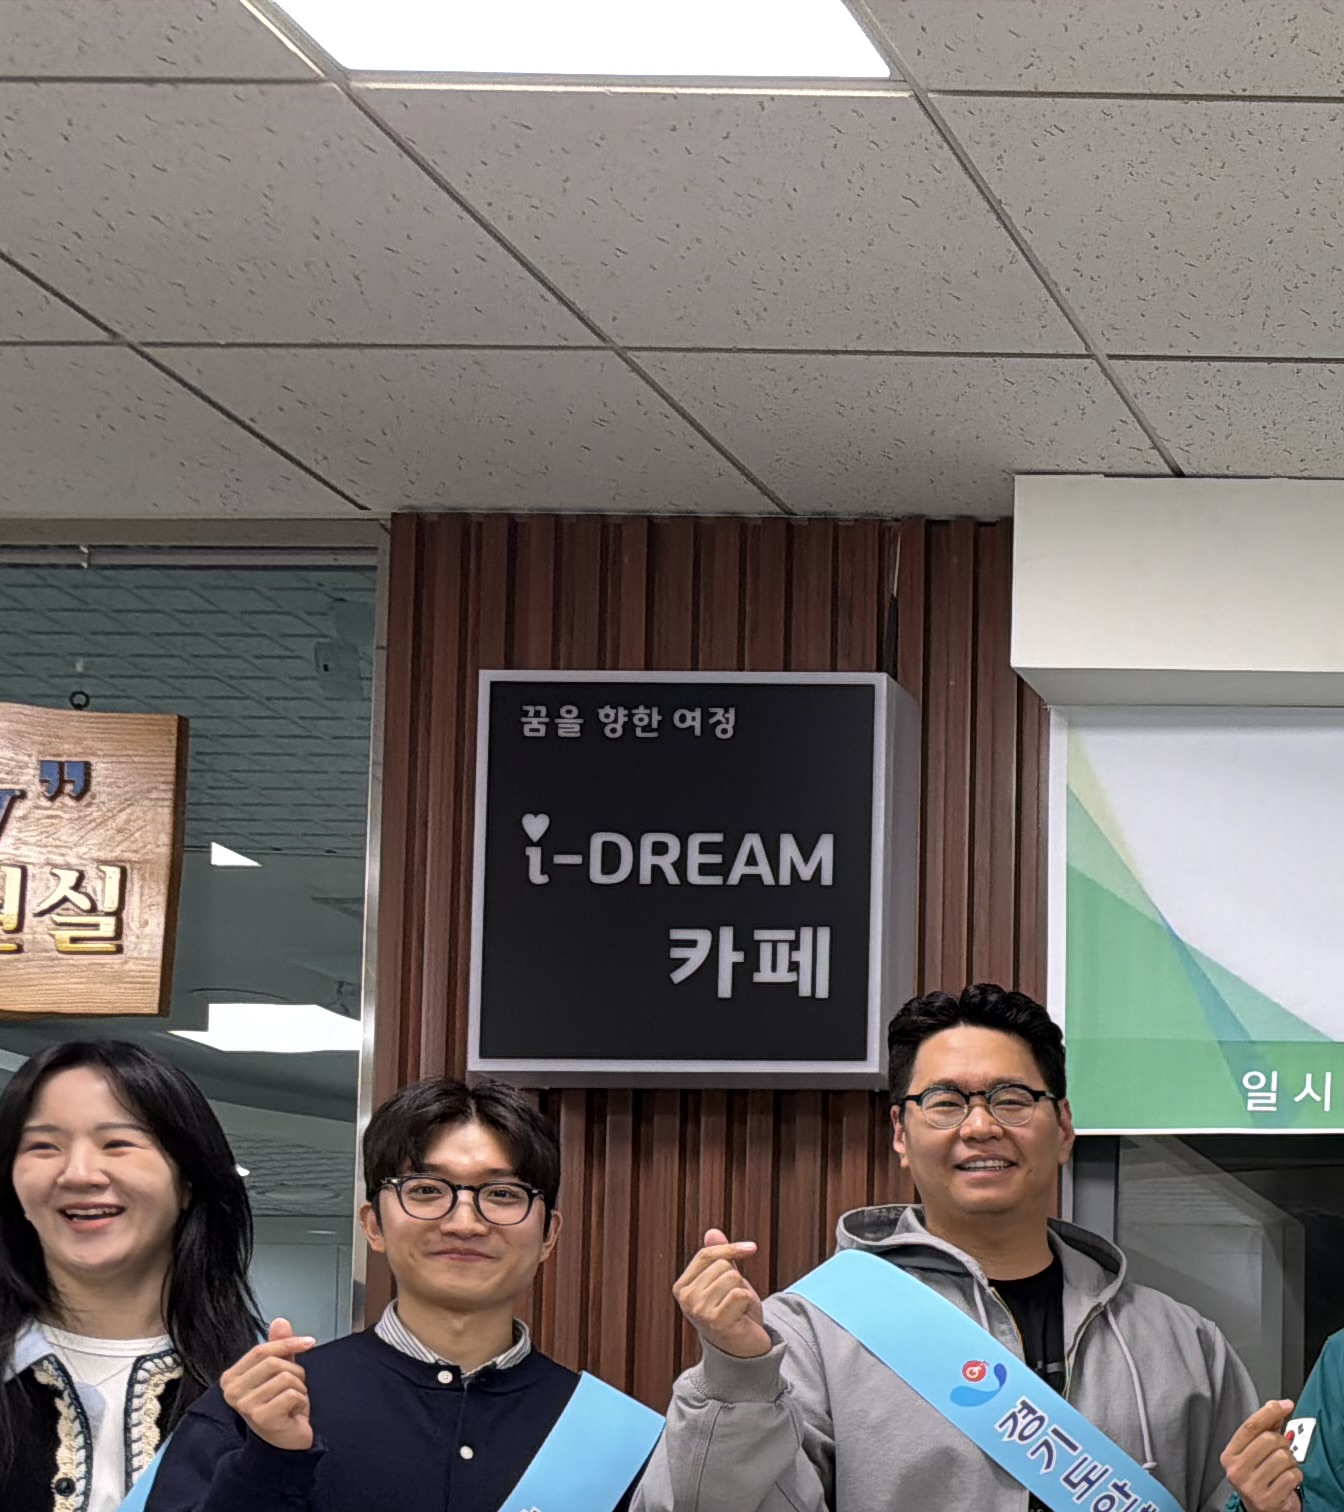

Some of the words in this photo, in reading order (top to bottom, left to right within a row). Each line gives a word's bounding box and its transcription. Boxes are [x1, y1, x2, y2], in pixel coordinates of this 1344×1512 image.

[521, 704, 585, 739] 꿈을
[598, 704, 663, 740] 향한
[673, 704, 738, 740] 여정
[521, 813, 835, 887] i-DREAM
[668, 925, 831, 999] 카페
